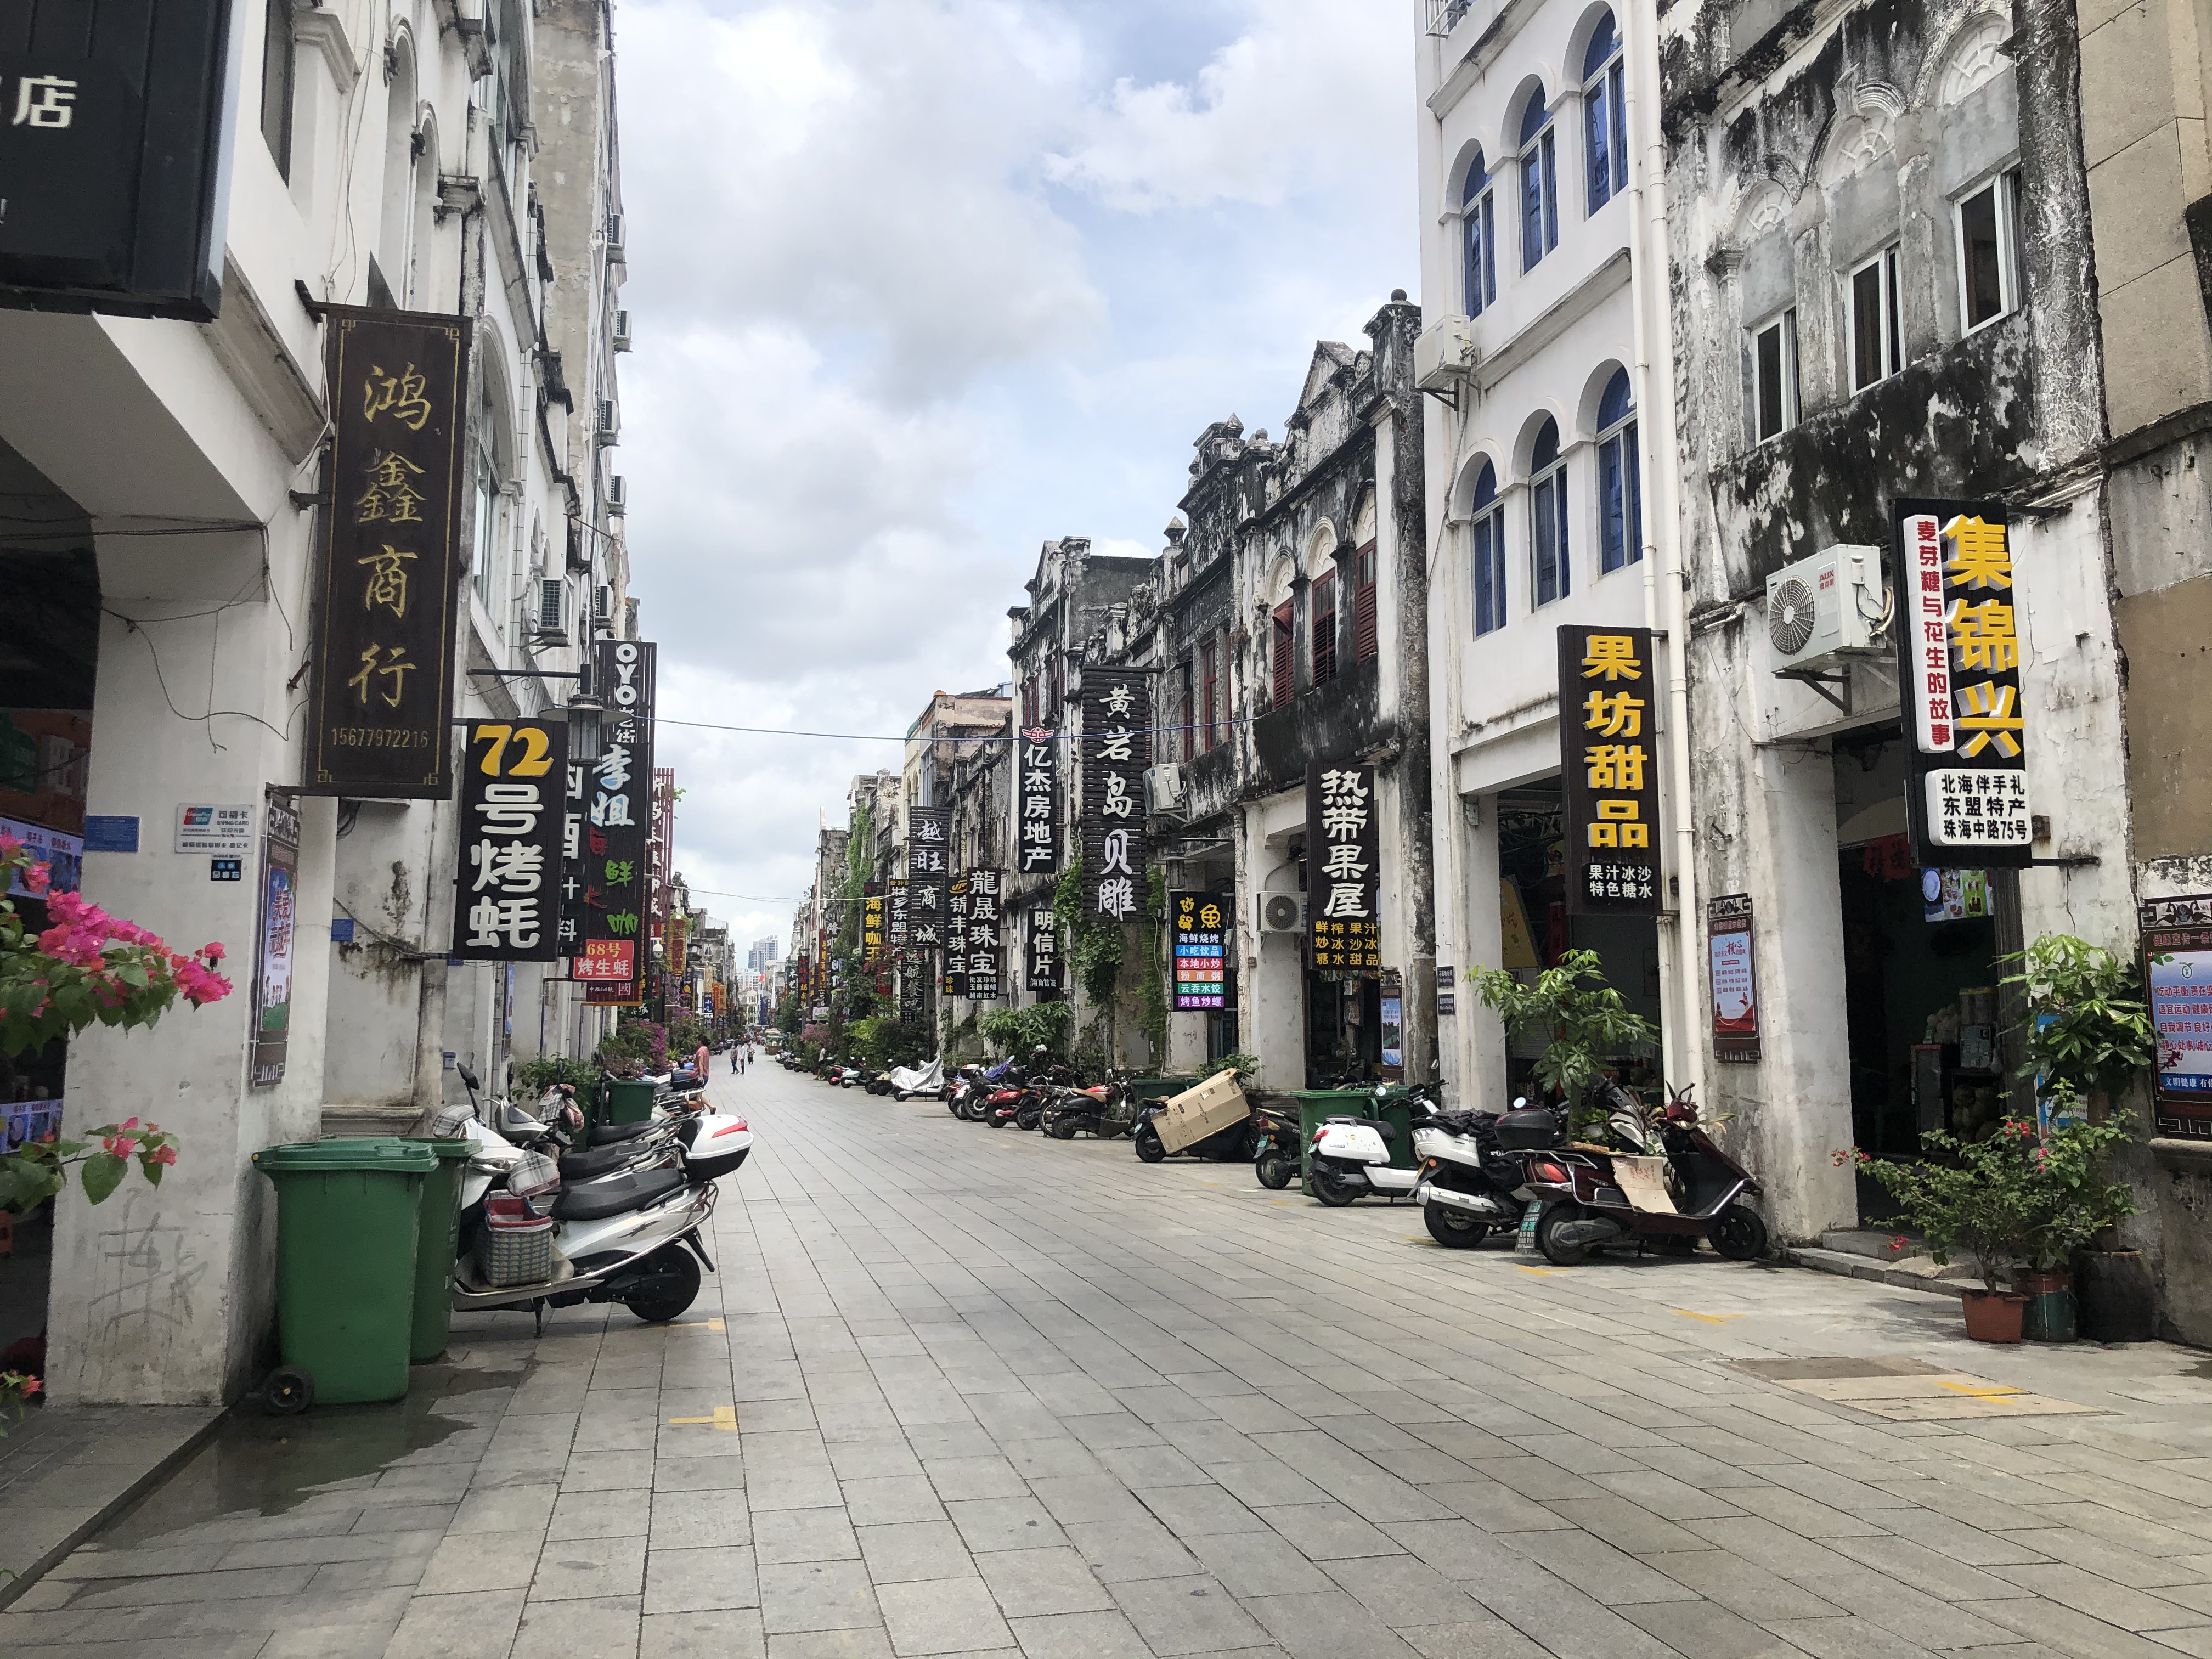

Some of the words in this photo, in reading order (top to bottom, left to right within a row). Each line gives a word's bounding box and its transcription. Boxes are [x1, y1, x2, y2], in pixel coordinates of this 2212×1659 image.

[348, 362, 432, 708] 鸿鑫商行
[1819, 570, 1834, 582] AUX
[1917, 520, 1951, 746] 麦芽糖与花生的故事
[1940, 514, 2025, 759] 集锦兴
[331, 727, 428, 748] 15677972216
[1581, 635, 1648, 849] 果坊甜品
[591, 744, 635, 827] 李姐
[1942, 774, 2025, 795] 北海伴手礼
[1023, 744, 1052, 872] 亿杰房地产
[1097, 684, 1137, 922] 黄岩岛贝雕
[1943, 796, 2027, 817] 东盟特产
[1944, 818, 2028, 840] 珠海中路75号
[1321, 769, 1369, 918] 热带果屋
[1589, 865, 1652, 879] 果汁冰沙
[915, 820, 945, 945] 越旺商城
[1589, 882, 1653, 899] 特色糖水
[865, 896, 882, 960] 海鲜咖王
[1316, 921, 1378, 935] 鲜榨果汁
[1032, 911, 1055, 976] 明信片
[1178, 933, 1220, 944] 海鲜烧烤
[1316, 935, 1378, 950] 炒冰沙冰
[587, 942, 622, 958] 68号
[1179, 945, 1220, 957] 小吃饮品
[578, 958, 629, 976] 烤生蚝
[1179, 958, 1221, 969] 本地小炒
[1316, 952, 1378, 966] 糖水甜品
[1180, 983, 1221, 994] 云吞水饺
[2157, 985, 2189, 997] 吃动平衡
[1180, 995, 1222, 1008] 烤鱼炒螺
[2158, 1003, 2191, 1015] 适宜运动
[2160, 1022, 2192, 1033] 自我调节
[2165, 1077, 2197, 1087] 文明健康
